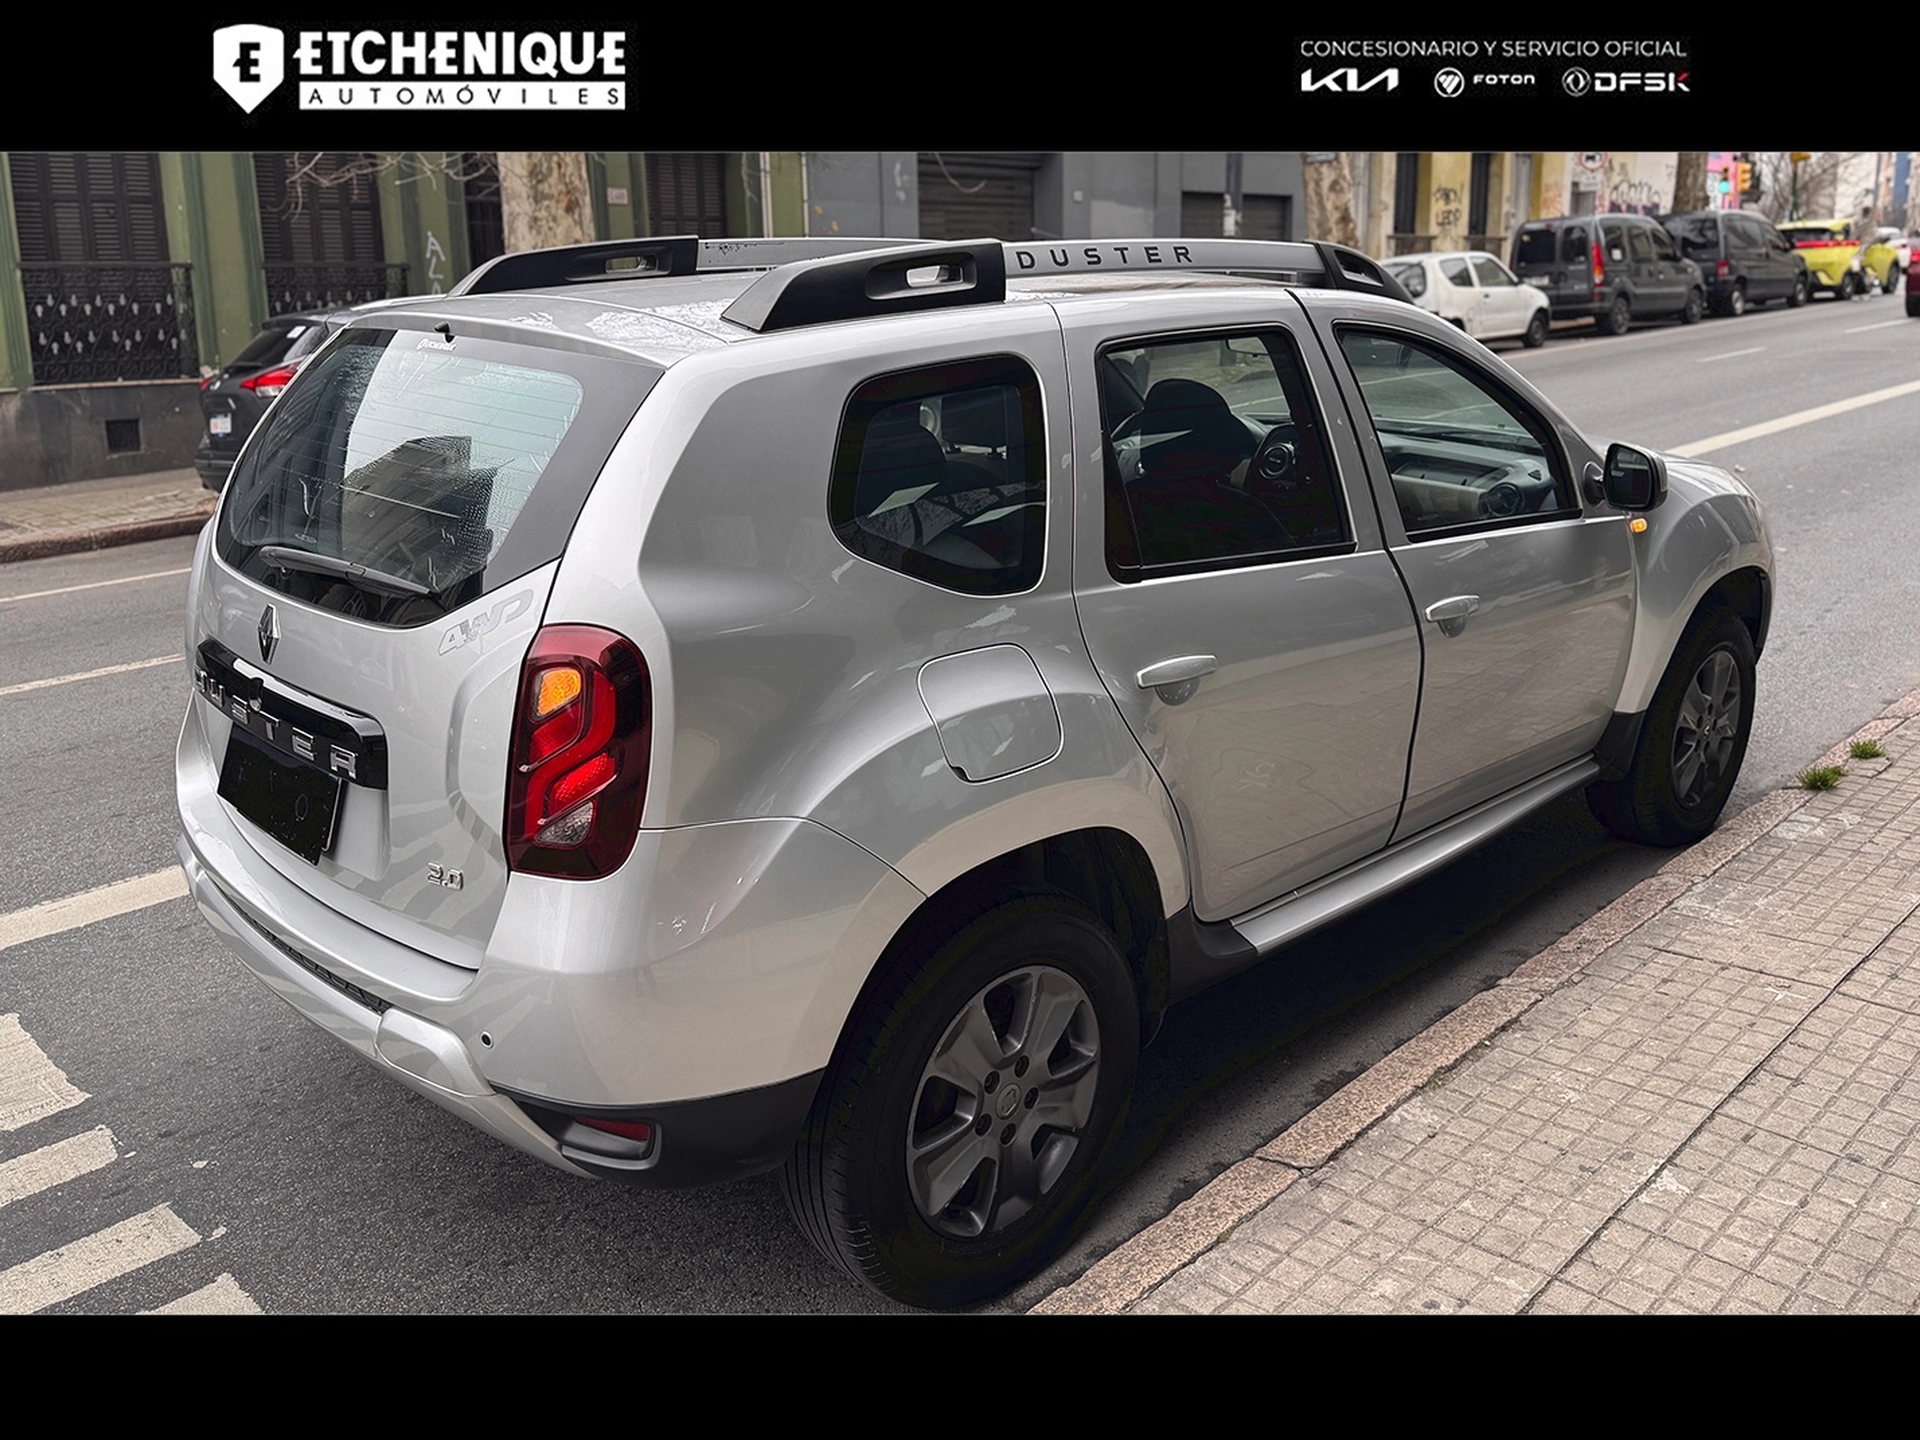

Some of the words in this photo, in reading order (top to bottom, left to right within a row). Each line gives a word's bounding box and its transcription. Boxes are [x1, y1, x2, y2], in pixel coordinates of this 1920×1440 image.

[1015, 246, 1193, 270] DUSTER
[437, 588, 535, 656] 4WD
[427, 861, 464, 891] 2.0
